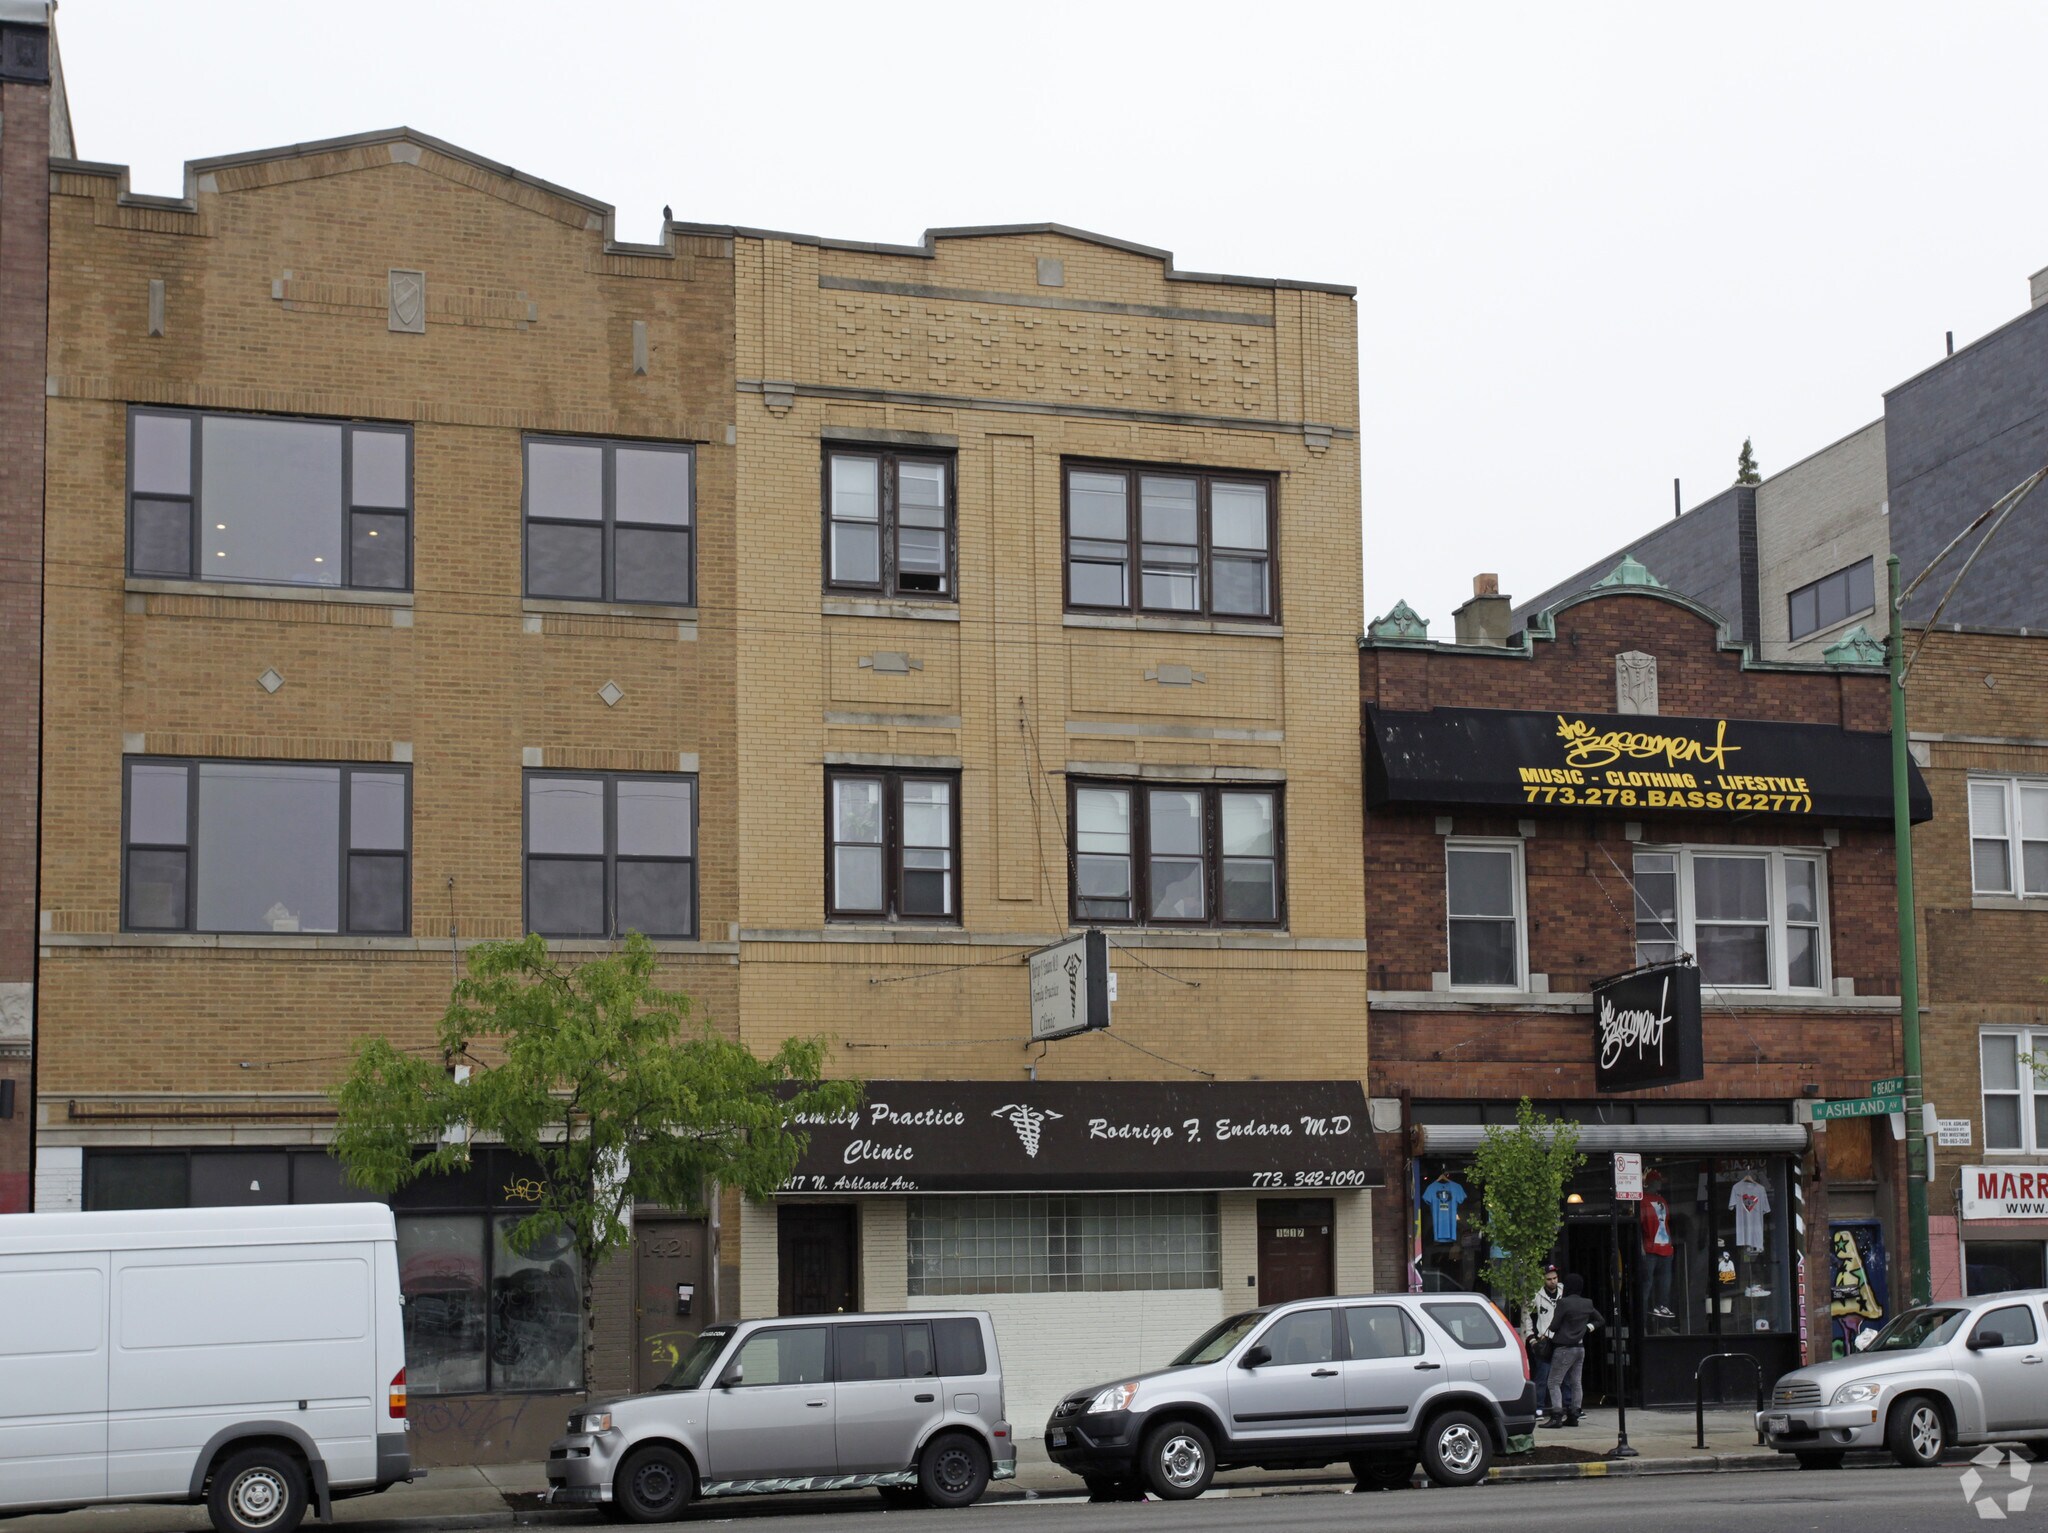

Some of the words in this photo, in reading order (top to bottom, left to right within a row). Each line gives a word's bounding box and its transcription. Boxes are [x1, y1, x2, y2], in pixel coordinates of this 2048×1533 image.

[1518, 767, 1585, 785] MUSIC
[1605, 770, 1698, 789] CLOTHING
[1717, 775, 1810, 793] LIFESTYLE
[1523, 785, 1812, 813] 773.278.BASS(2277)
[1877, 1081, 1895, 1095] BEACH
[779, 1103, 860, 1130] amily
[870, 1103, 965, 1126] Practice
[1817, 1108, 1822, 1116] N
[1825, 1100, 1886, 1117] ASHLAND
[1889, 1101, 1897, 1109] AV
[1088, 1118, 1173, 1145] Rodrigo
[1216, 1118, 1292, 1140] Endara
[1300, 1115, 1351, 1136] M.D
[843, 1139, 914, 1164] Clinic
[812, 1175, 828, 1190] N.
[833, 1175, 888, 1190] Ashland
[889, 1175, 919, 1190] Ave.
[1252, 1171, 1287, 1187] 773.
[1294, 1170, 1365, 1187] 342-1090
[1276, 1228, 1305, 1238] 1417
[643, 1240, 692, 1258] 1421
